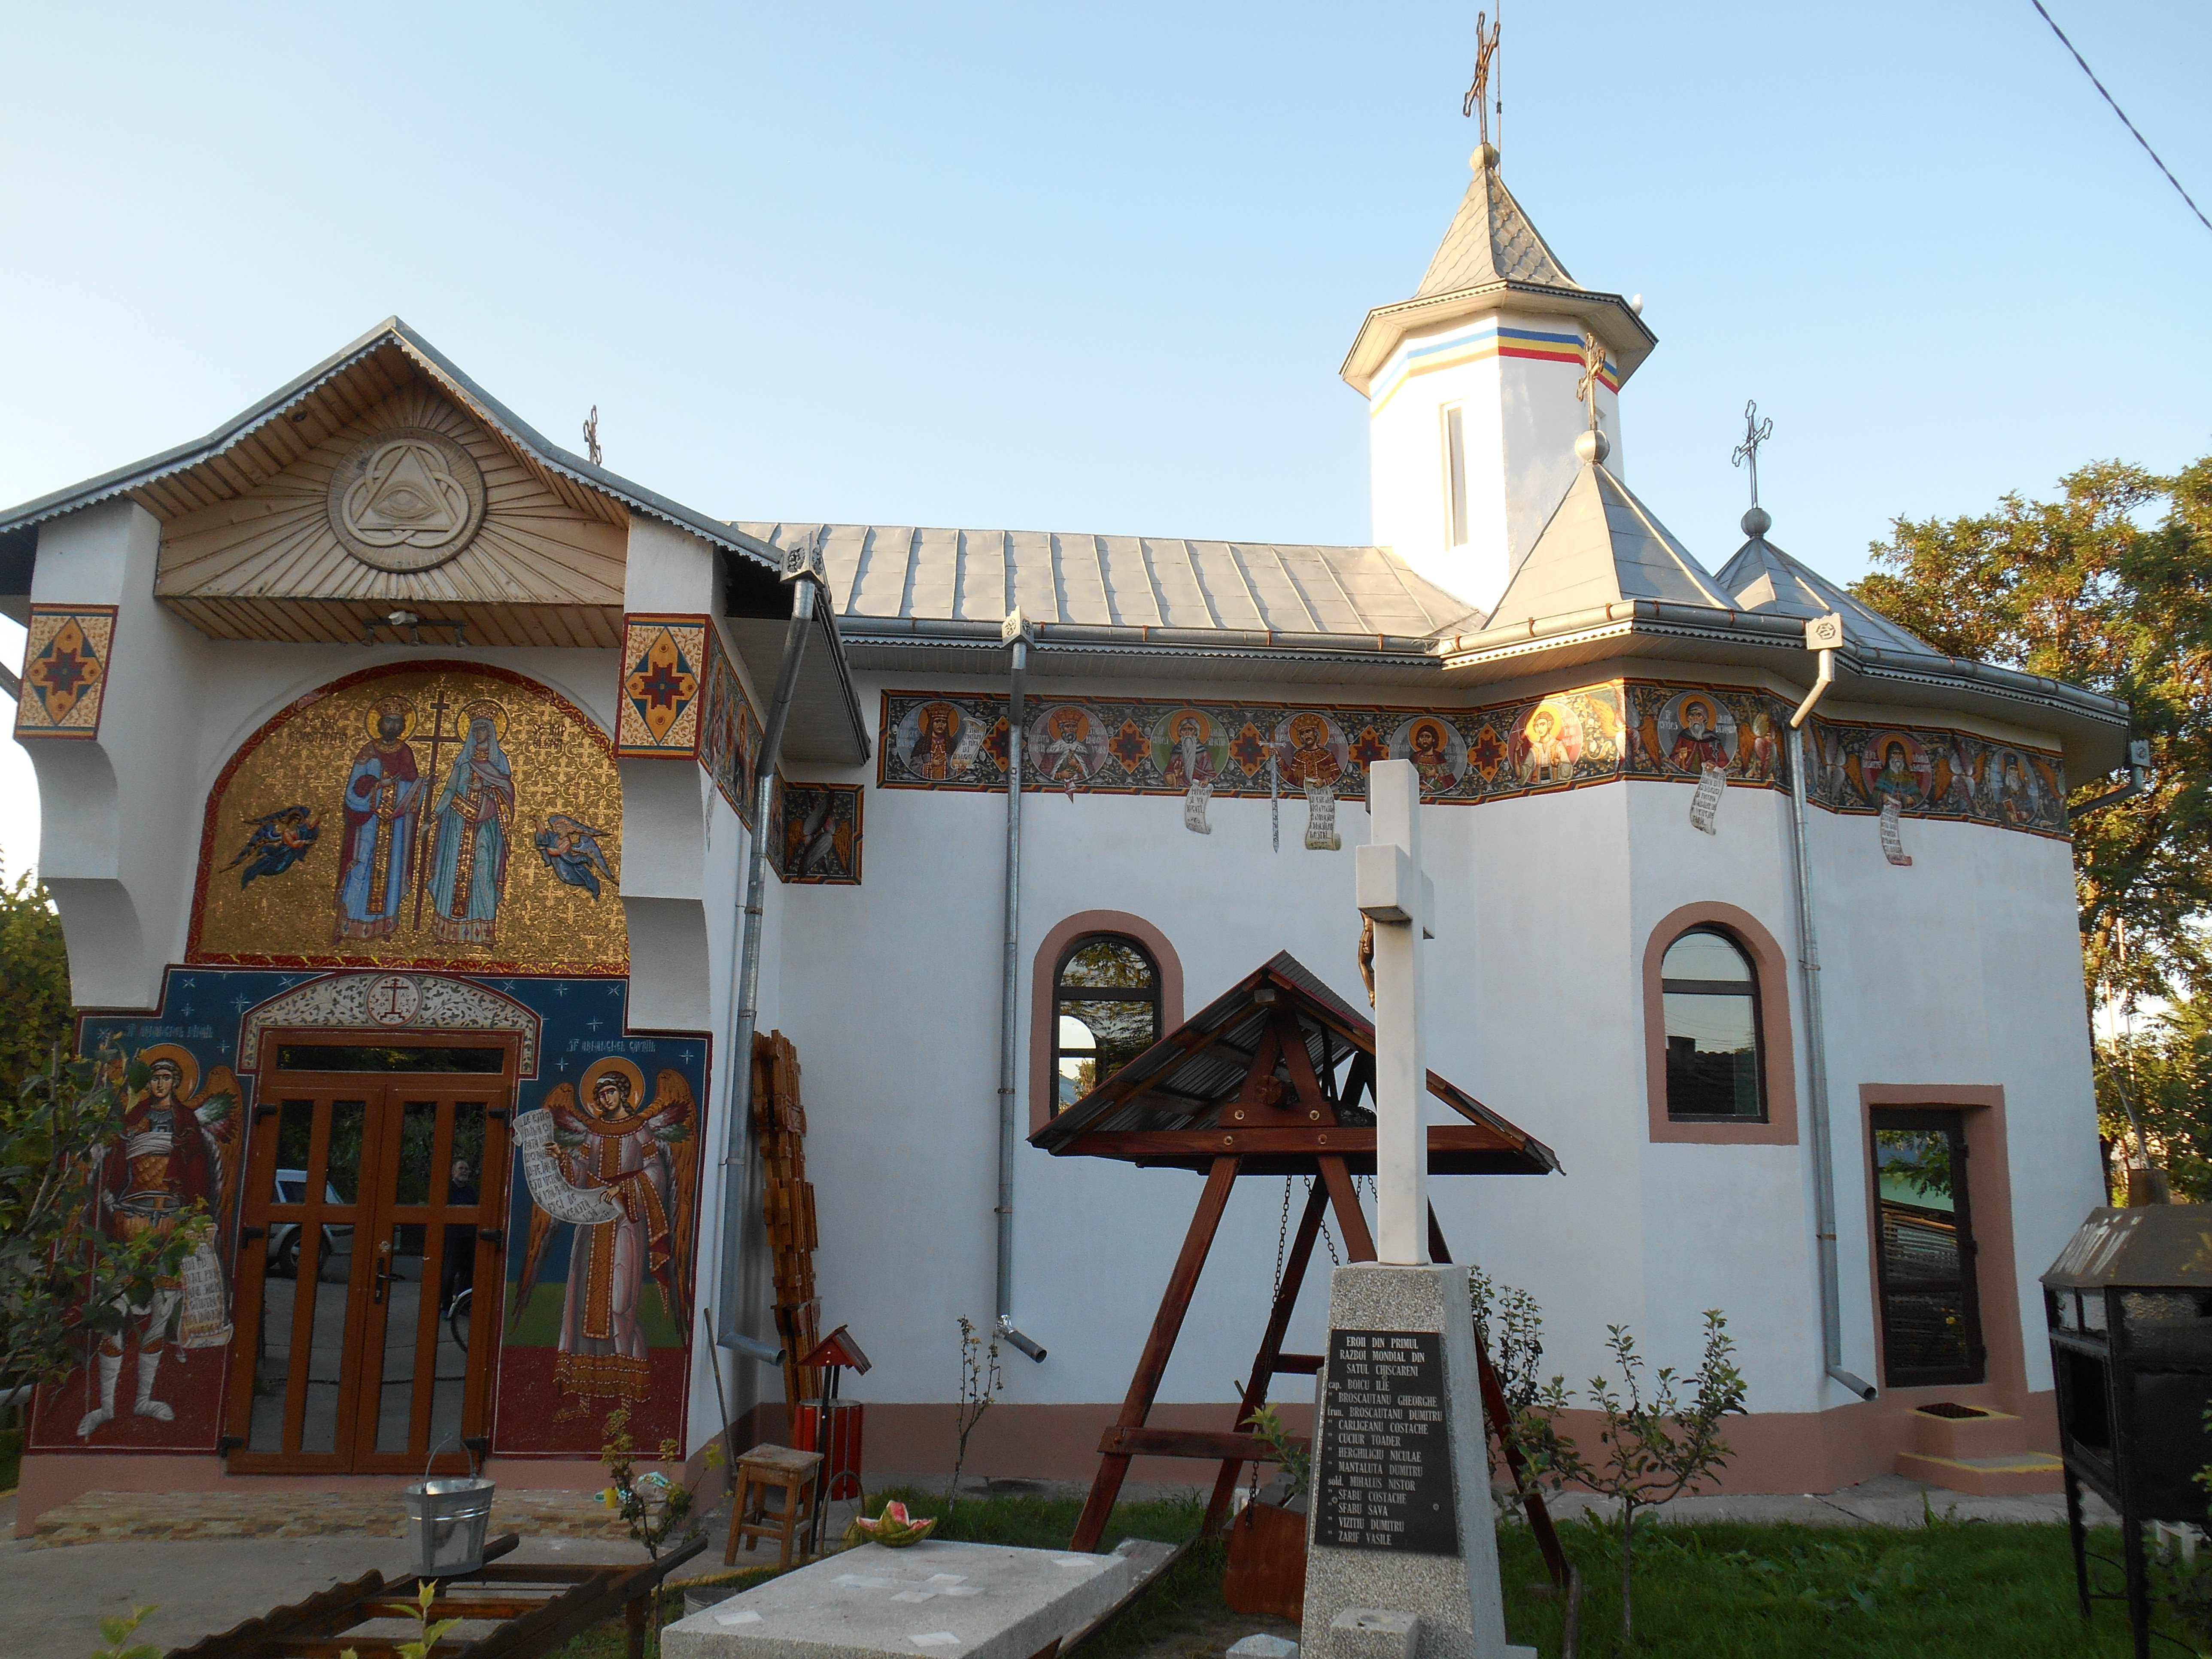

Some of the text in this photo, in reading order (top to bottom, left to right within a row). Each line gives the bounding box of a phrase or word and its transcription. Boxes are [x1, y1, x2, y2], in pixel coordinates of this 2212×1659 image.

[1346, 1337, 1419, 1349] EROII DIN PRIMUL
[1340, 1350, 1425, 1362] RAZBOI MONDIAL DIN
[1347, 1364, 1418, 1376] SATUL CHISCARENI
[1328, 1379, 1390, 1391] cap. BOICU ILIE
[1339, 1392, 1391, 1405] BROSCAUTANU
[1398, 1395, 1437, 1407] GHEORGHE
[1328, 1406, 1442, 1422] frun. BROSCAUTANU DUMITRU
[1339, 1420, 1383, 1432] CARLIGEANU
[1390, 1422, 1428, 1434] COSTACHE
[1339, 1433, 1364, 1444] CUCIUR
[1371, 1435, 1401, 1446] TOADER
[1339, 1447, 1384, 1459] HERGHILIGIU
[1390, 1450, 1422, 1462] NICULAE
[1339, 1461, 1382, 1474] MANTALUTA
[1389, 1464, 1423, 1477] DUMITRU
[1328, 1475, 1415, 1491] sold. MIHALUS NISTOR
[1339, 1489, 1362, 1501] SFABU
[1368, 1491, 1407, 1504] COSTACHE
[1339, 1503, 1362, 1514] SFABU
[1368, 1504, 1388, 1516] SAVA
[1339, 1516, 1364, 1529] VIZITIU
[1371, 1519, 1404, 1532] DUMITRU
[1339, 1531, 1360, 1543] ZARIF
[1366, 1533, 1392, 1545] VASILE
